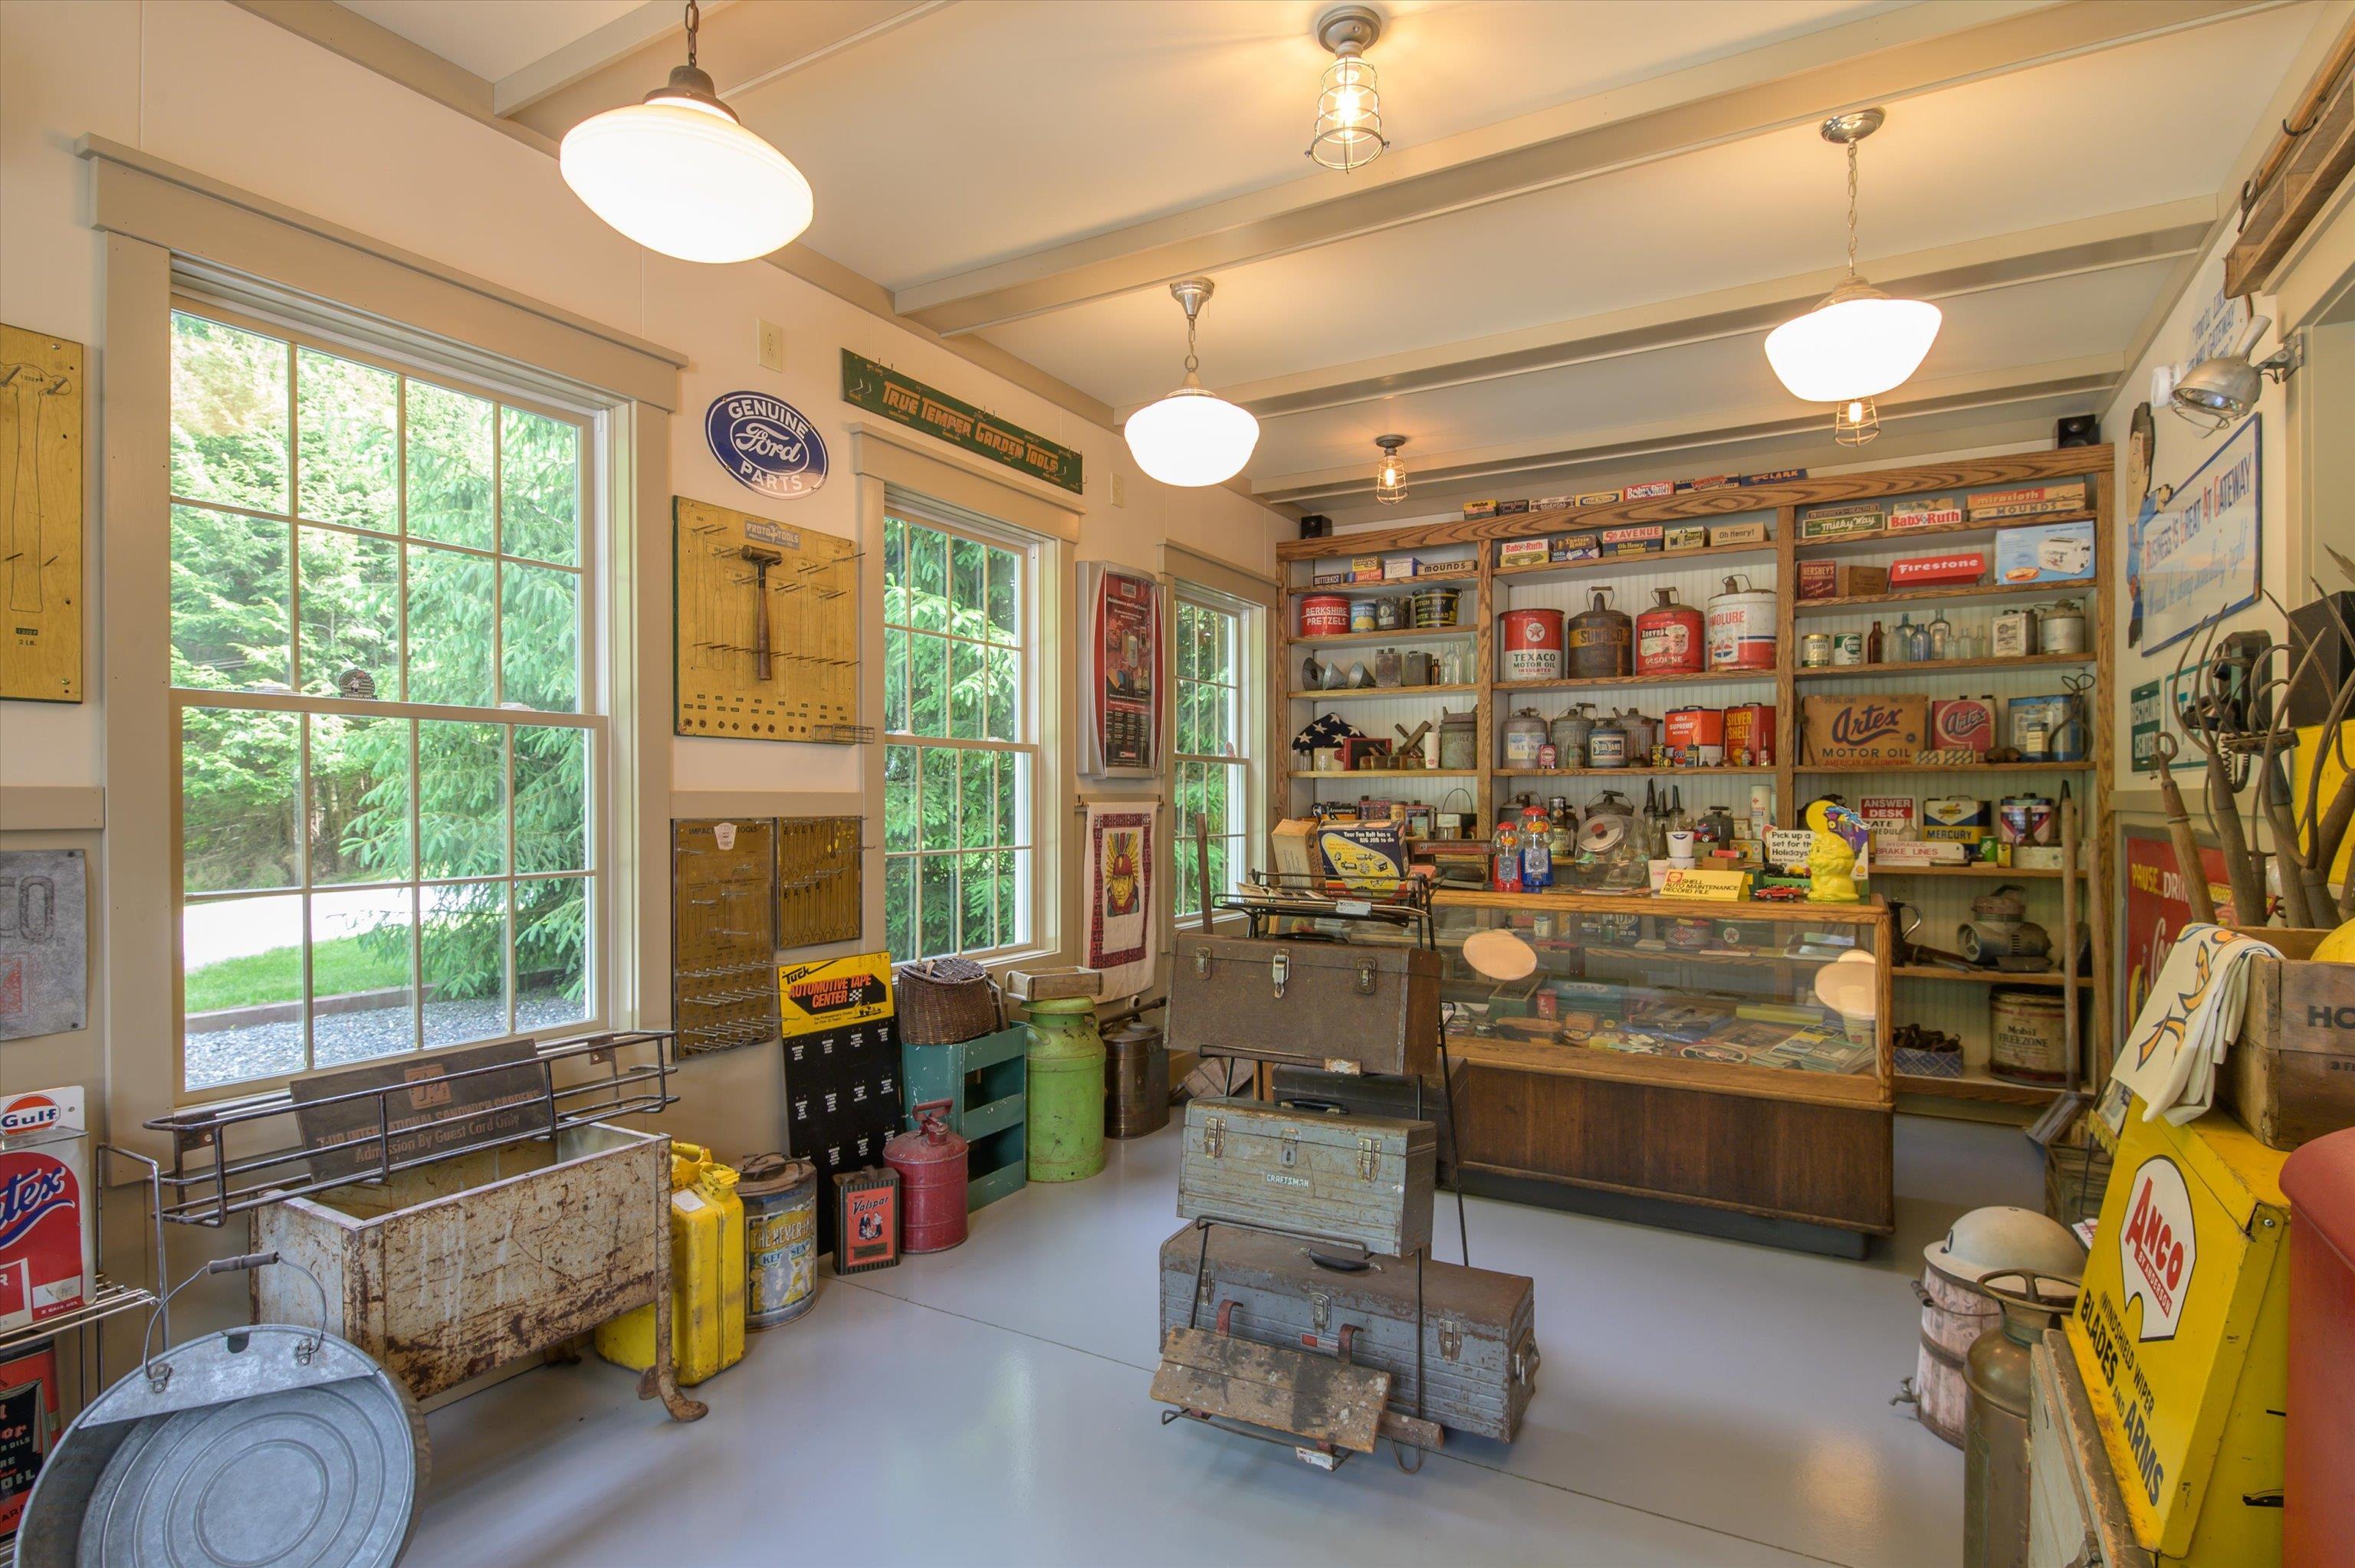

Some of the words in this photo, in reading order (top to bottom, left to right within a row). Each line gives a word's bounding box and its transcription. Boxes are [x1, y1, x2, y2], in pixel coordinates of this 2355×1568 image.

[728, 399, 809, 440] GENUINE
[882, 381, 920, 415] TRUE
[921, 397, 975, 438] TEMPER
[975, 422, 1024, 459] GARDEN
[1026, 443, 1059, 473] TOOLS
[735, 422, 803, 464] Ford
[740, 460, 803, 491] PARTS
[1627, 487, 1647, 500] Baby
[1978, 490, 2039, 505] miracloth
[2180, 498, 2201, 544] GREAT
[2203, 487, 2212, 523] AT
[2214, 452, 2252, 518] GATEWAY
[1997, 503, 2058, 516] MOUNDS
[1821, 520, 1853, 531] Milky
[1854, 516, 1875, 525] Way
[1891, 515, 1922, 527] Baby
[1928, 510, 1959, 524] Ruth
[747, 522, 770, 537] PROTO
[777, 530, 799, 543] TOOLS
[1605, 531, 1618, 543] 5th
[1621, 527, 1660, 537] AVENUE
[1730, 529, 1755, 537] Henry!
[1506, 543, 1522, 553] Baby
[1526, 541, 1543, 551] Ruth
[1424, 562, 1466, 572] MOUNDS
[1802, 566, 1834, 576] HERSHEY'S
[1898, 559, 1979, 574] Firestone
[1306, 606, 1347, 616] BERKSHIRE
[1307, 617, 1346, 626] PRETZELS
[1513, 653, 1555, 662] TEXACO
[1726, 711, 1752, 726] SILVER
[1831, 704, 1903, 746] Artex
[1728, 726, 1751, 740] SHELL
[1822, 748, 1879, 758] MOTOR
[1887, 748, 1911, 758] OIL
[1864, 799, 1911, 808] ANSWER
[1869, 809, 1905, 818] DESK
[1926, 830, 1972, 840] MERCURY
[782, 964, 823, 985] Tuck
[789, 977, 849, 999] AUTOMOTIVE
[850, 973, 872, 989] TAPE
[812, 990, 848, 1009] CENTER
[2007, 1025, 2037, 1035] Mobil
[1999, 1035, 2048, 1048] FREEZONE
[2, 1108, 57, 1128] Gulf
[418, 1134, 433, 1150] By
[435, 1125, 466, 1143] Guest
[469, 1119, 494, 1135] Card
[495, 1114, 520, 1130] Only
[1266, 1173, 1309, 1187] CRAFTSMAN
[852, 1196, 890, 1216] Valspar
[753, 1230, 770, 1249] THE
[2125, 1176, 2183, 1291] ANCO
[2137, 1251, 2146, 1268] BY
[2145, 1264, 2173, 1315] ANDERSON
[2100, 1291, 2134, 1371] WINDSHIELD
[2133, 1363, 2155, 1420] WIPER
[2080, 1288, 2118, 1388] BLADES
[2112, 1385, 2125, 1418] AND
[2123, 1399, 2164, 1507] ARMS
[9, 1437, 31, 1450] OILS
[1, 1470, 36, 1489] OIL
